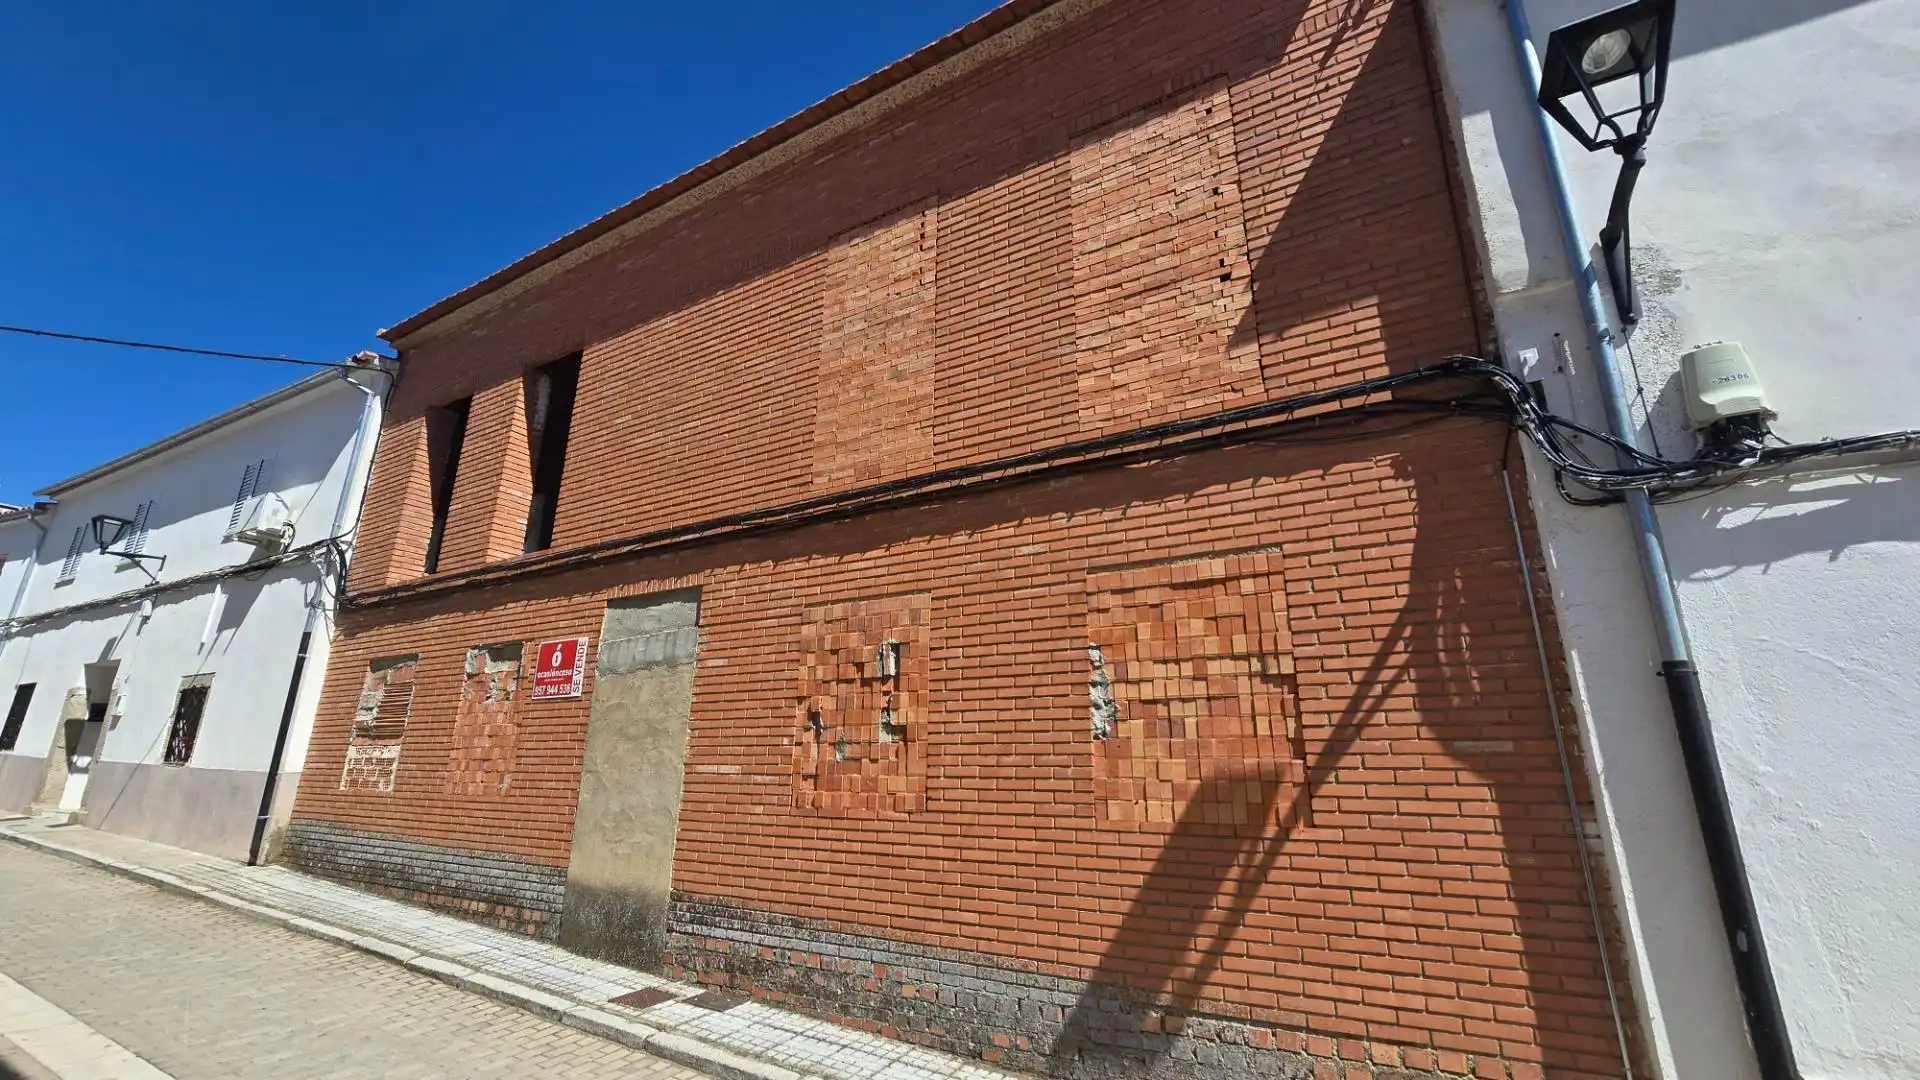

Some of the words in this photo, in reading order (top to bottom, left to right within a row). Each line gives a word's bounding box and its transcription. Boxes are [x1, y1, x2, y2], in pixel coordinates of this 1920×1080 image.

[574, 640, 586, 676] VENDE
[546, 684, 559, 695] 944
[573, 680, 581, 693] SE
